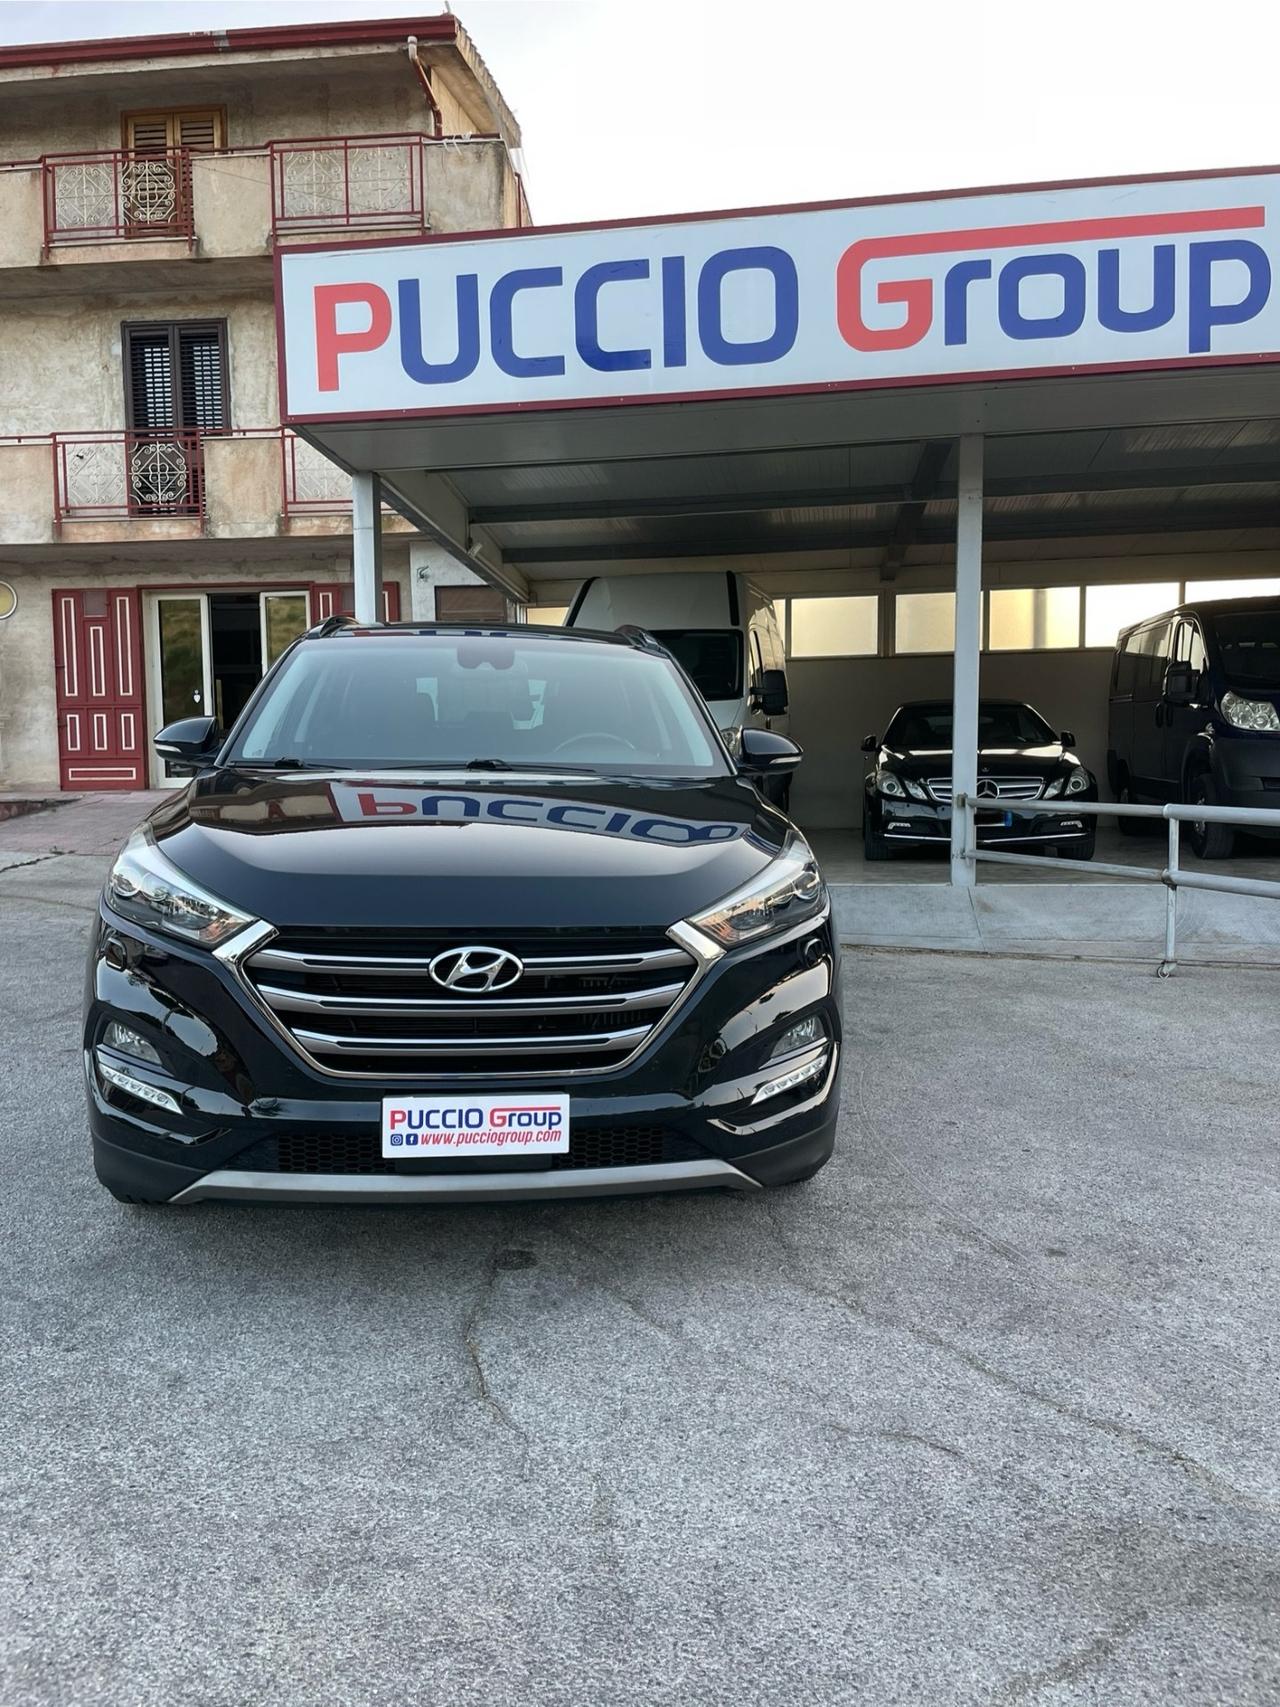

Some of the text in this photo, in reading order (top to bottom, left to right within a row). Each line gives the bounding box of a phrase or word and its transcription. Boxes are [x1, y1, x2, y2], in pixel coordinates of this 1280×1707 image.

[313, 205, 1272, 392] PUCCIO Group
[389, 1106, 562, 1130] PUCCIO Group
[420, 1128, 562, 1147] www.pucciogroup.com
